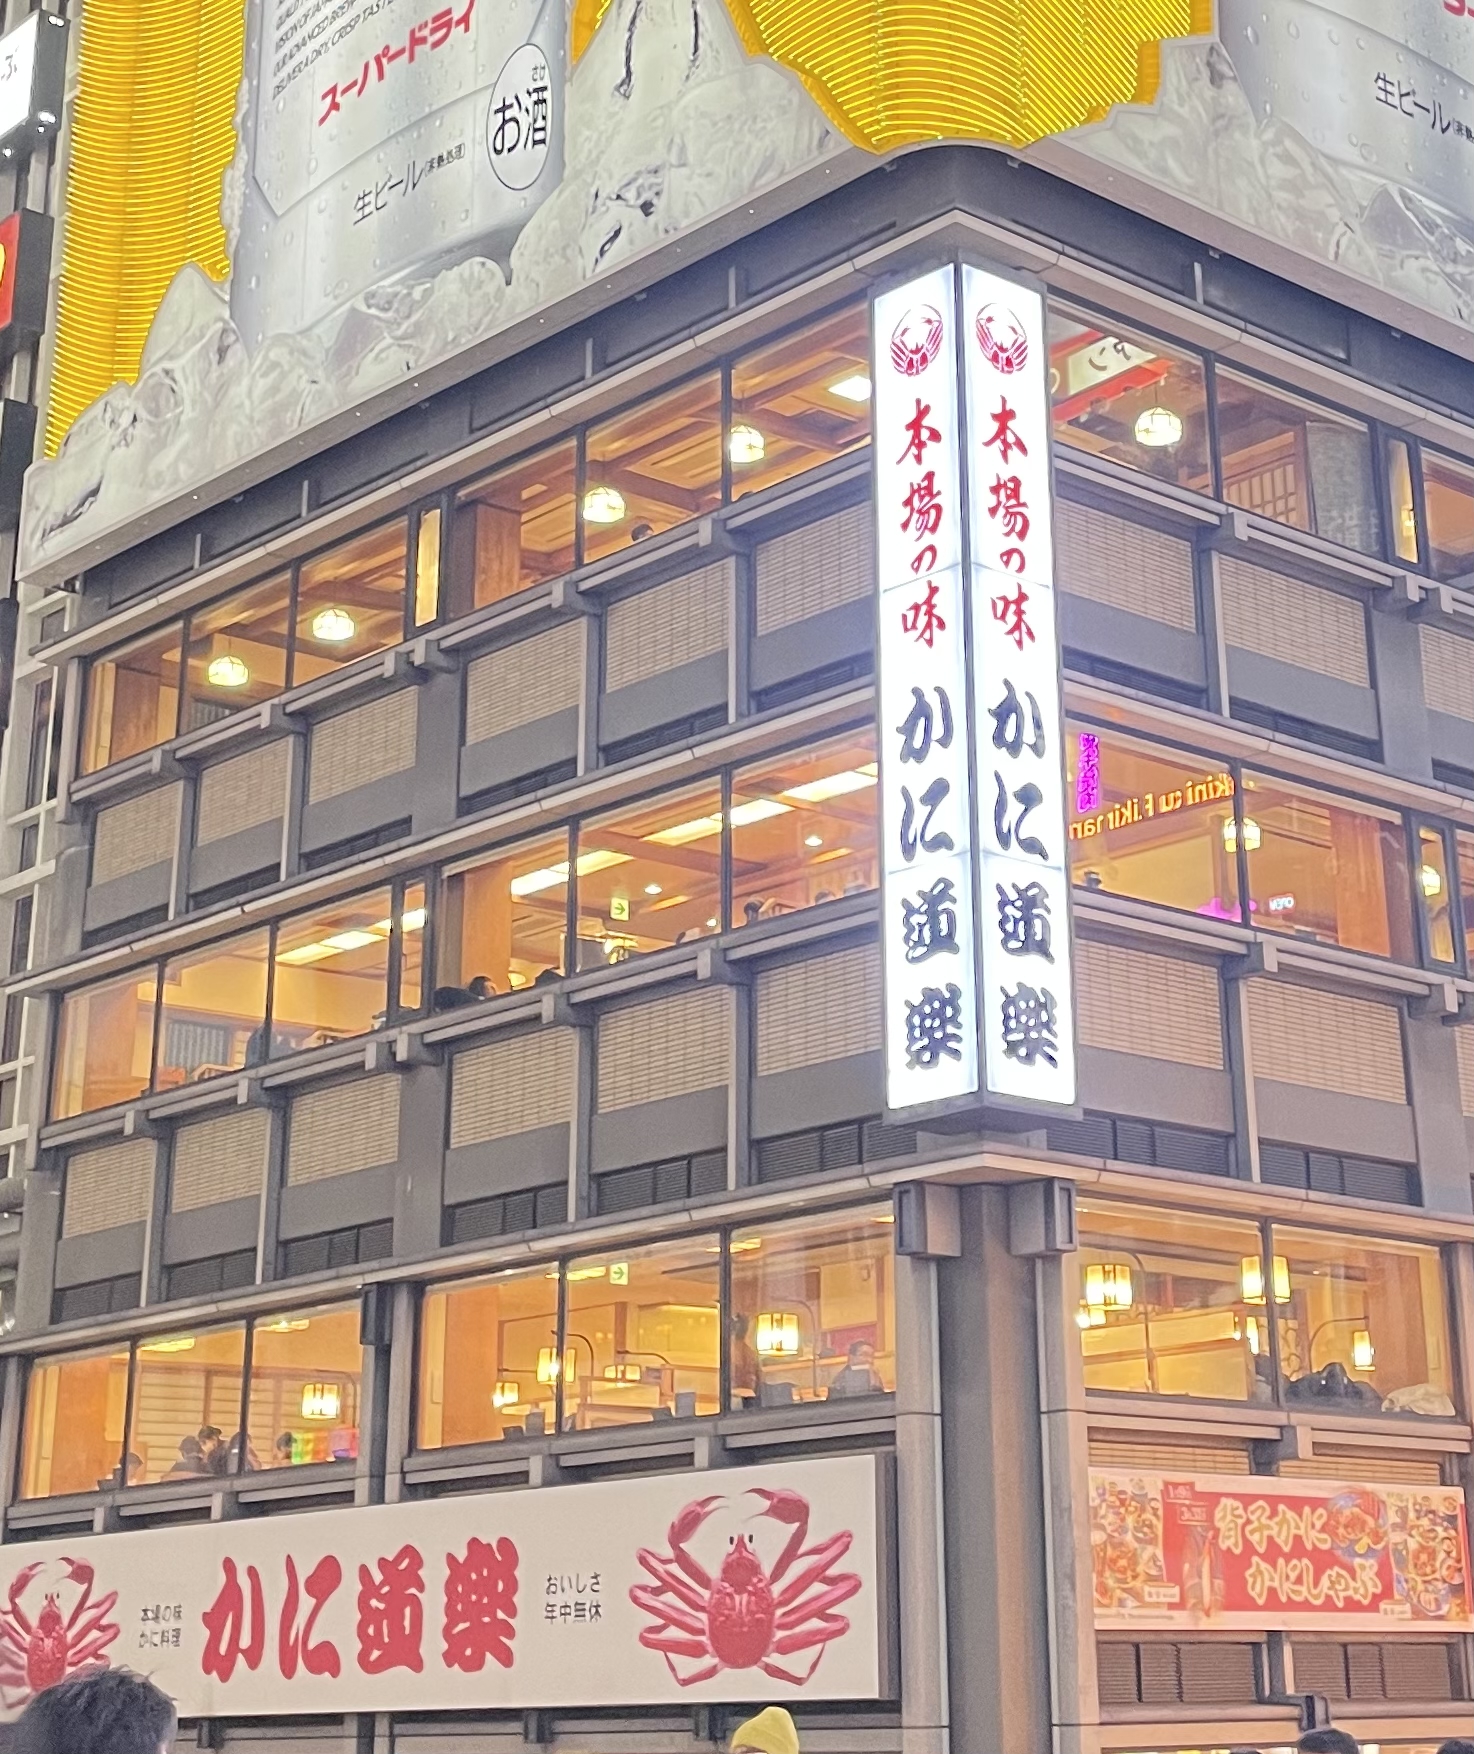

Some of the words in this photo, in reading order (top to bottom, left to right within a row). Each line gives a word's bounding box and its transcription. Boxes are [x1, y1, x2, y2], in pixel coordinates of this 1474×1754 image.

[318, 0, 476, 127] スーパードライ
[492, 85, 549, 156] お酒
[896, 397, 946, 649] 本場の味
[982, 395, 1036, 651] 本場の味
[544, 1599, 602, 1625] 年中無休
[545, 1571, 601, 1595] おいしさ
